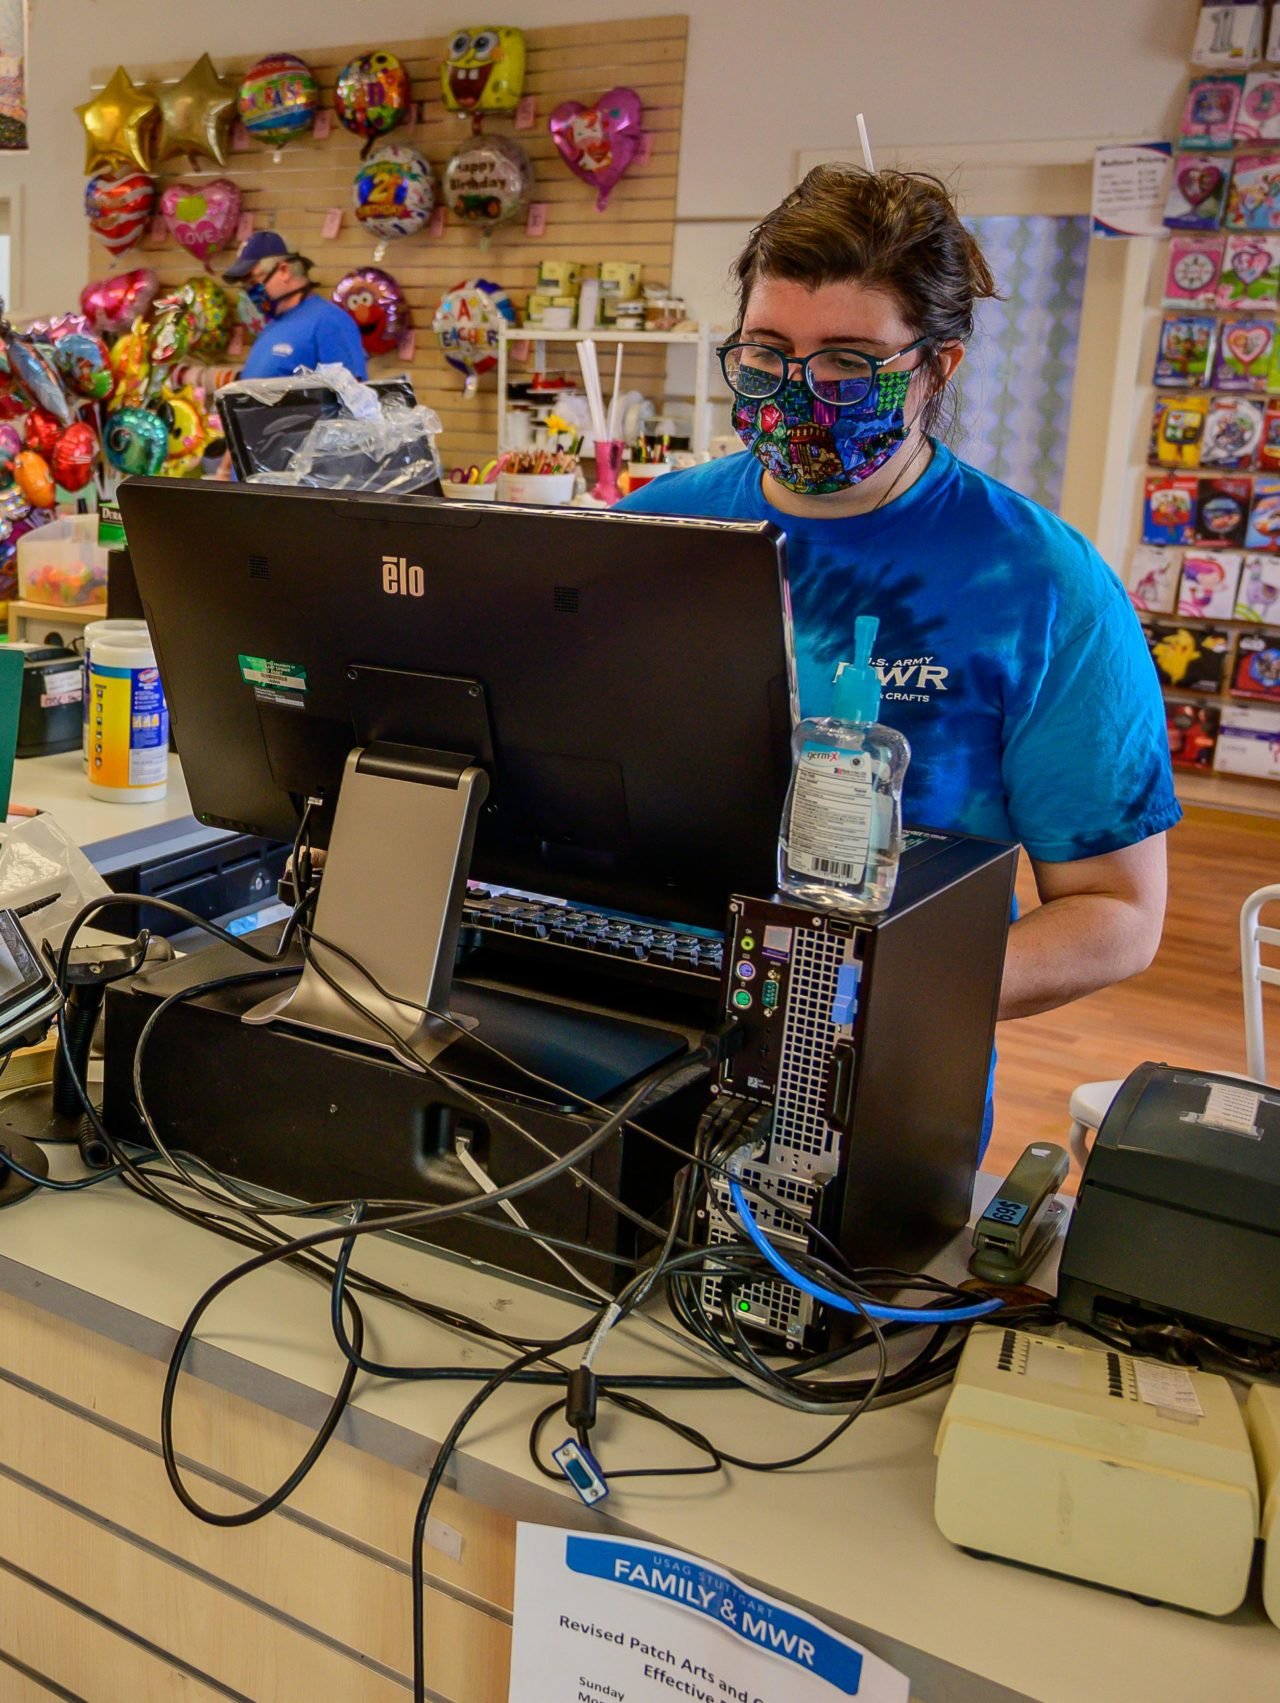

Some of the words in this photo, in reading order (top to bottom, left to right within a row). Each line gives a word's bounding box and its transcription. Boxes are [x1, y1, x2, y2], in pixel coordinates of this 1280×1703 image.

[449, 177, 506, 191] Birthday
[438, 326, 499, 348] EACHER
[893, 656, 934, 667] ARMY
[885, 692, 930, 703] CRAFTS
[653, 1555, 692, 1577] USAG
[698, 1571, 774, 1619] STUTTGART
[614, 1558, 717, 1609] FAMILY
[720, 1598, 738, 1625] &
[742, 1611, 816, 1667] MWR
[559, 1614, 625, 1646] Revised
[630, 1636, 677, 1666] Patch
[681, 1658, 715, 1684] Arts
[719, 1678, 749, 1703] and
[578, 1676, 625, 1702] Sunday
[644, 1664, 716, 1703] Effective
